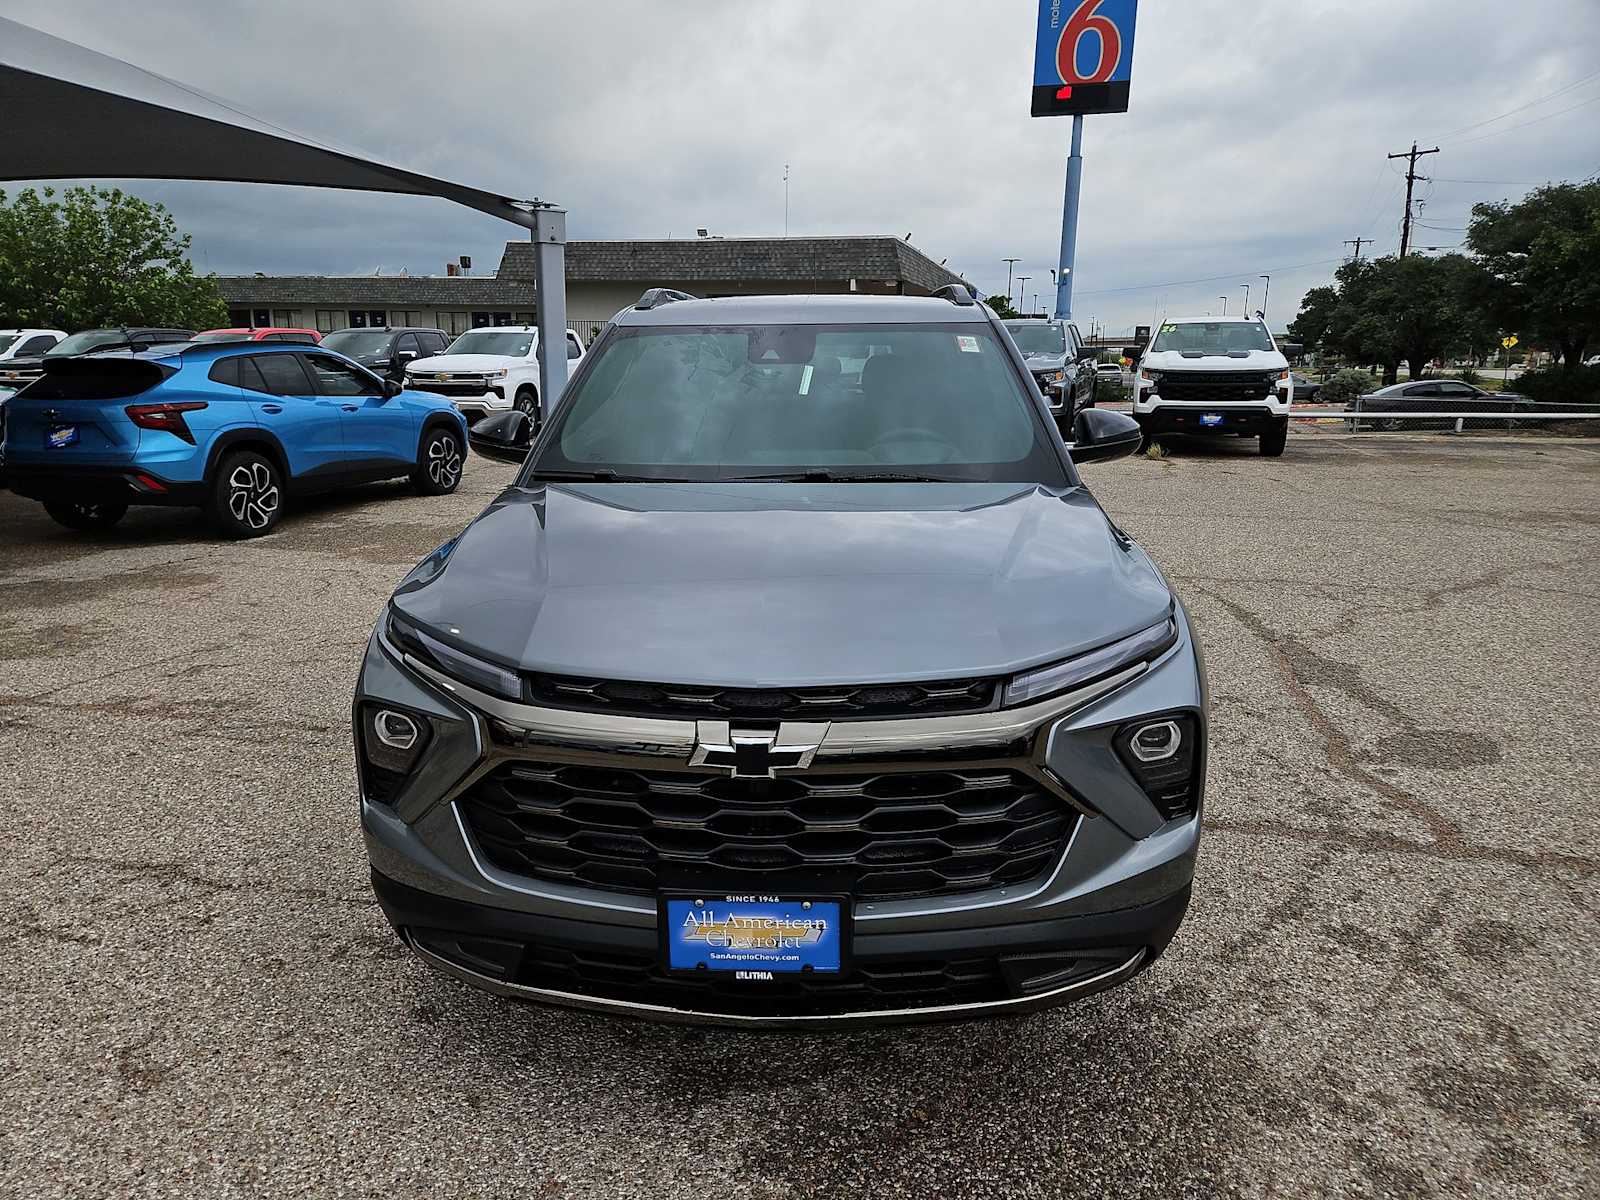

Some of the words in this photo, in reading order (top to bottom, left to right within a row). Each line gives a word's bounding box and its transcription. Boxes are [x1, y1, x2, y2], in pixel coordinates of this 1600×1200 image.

[1056, 0, 1122, 85] 6
[683, 911, 714, 928] All
[723, 913, 828, 930] American
[706, 930, 801, 949] Chevrolet
[710, 953, 800, 962] SanAngeloChevy.com
[744, 971, 773, 980] LITHIA
